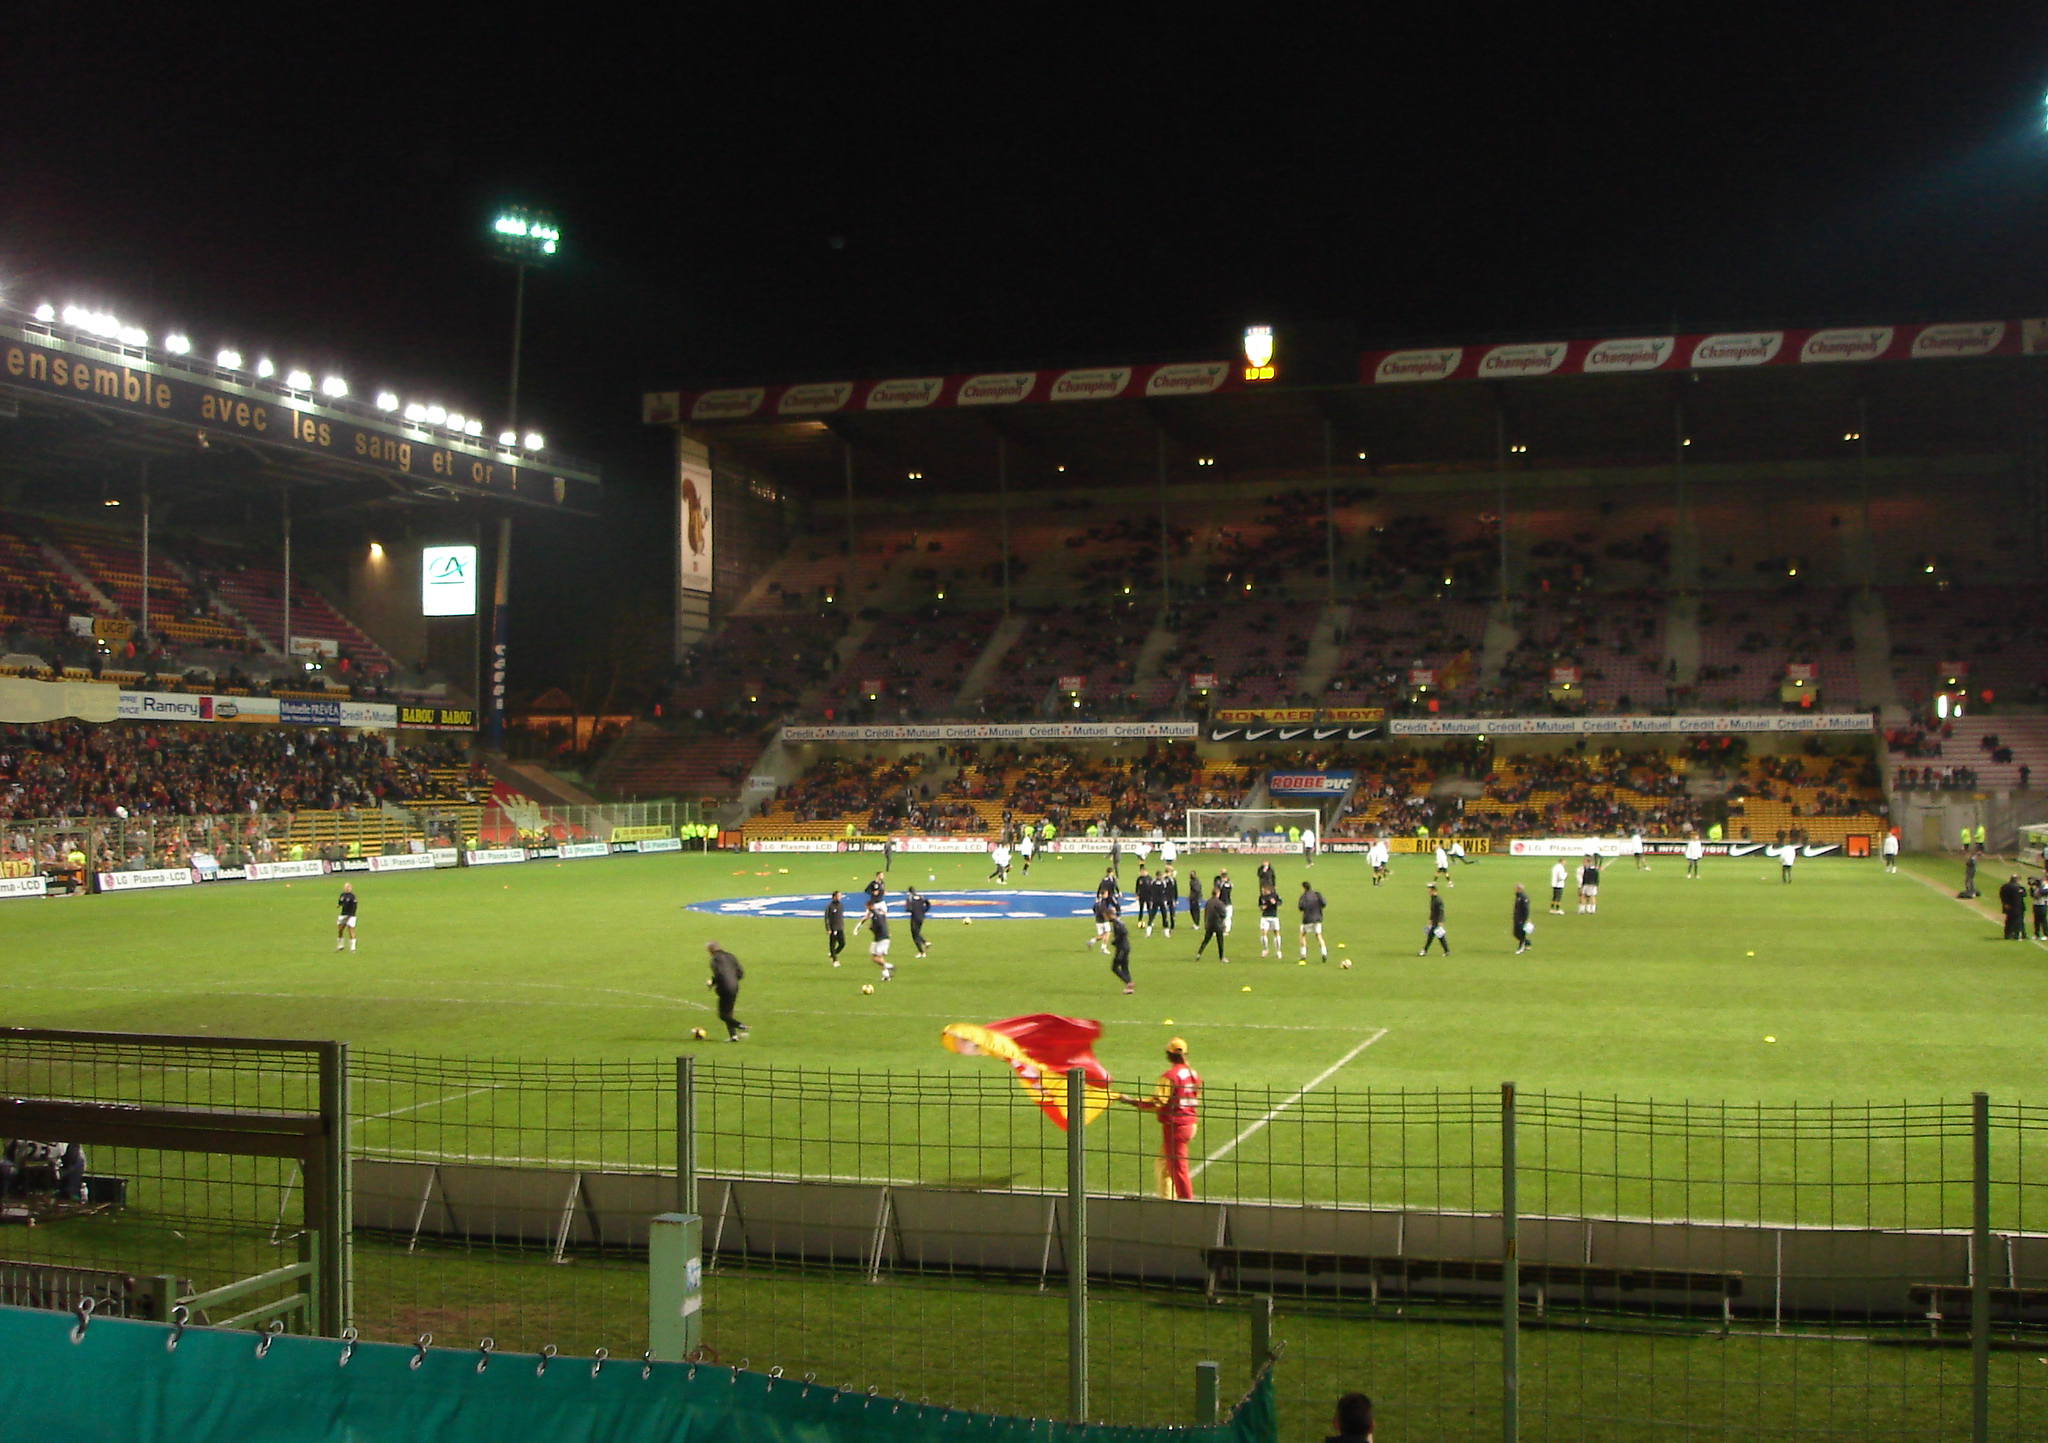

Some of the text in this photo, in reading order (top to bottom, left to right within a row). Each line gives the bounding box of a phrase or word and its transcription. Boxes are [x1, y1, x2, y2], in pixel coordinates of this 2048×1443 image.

[1485, 354, 1554, 372] Champion
[1591, 348, 1658, 366] Champion
[1382, 360, 1448, 377] Champion
[1057, 379, 1118, 395] Champion
[1152, 374, 1216, 391] Champion
[6, 347, 172, 409] ensemble
[202, 394, 267, 431] avec
[292, 409, 331, 446] les
[355, 432, 411, 472] sang
[432, 450, 453, 476] et
[472, 461, 494, 484] or
[143, 697, 199, 716] Ramery
[402, 708, 472, 726] BABOU BABOU
[1442, 722, 1480, 732] Mutuel
[1536, 721, 1575, 731] Mutuel
[1632, 719, 1671, 730] Mutuel
[1730, 718, 1770, 729] Mutuel
[1829, 717, 1870, 728] Mutuel
[827, 729, 859, 738] Mutuel
[907, 728, 940, 738] Mutuel
[988, 727, 1023, 737] Mutuel
[1073, 726, 1108, 735] Mutuel
[1159, 725, 1194, 734] Mutuel
[1271, 775, 1326, 790] ROBBE
[1333, 844, 1370, 852] Mobiles
[259, 863, 319, 875] LG Plasma LCD
[21, 881, 40, 891] LCD
[117, 876, 127, 885] LG
[133, 873, 164, 884] Plasma
[170, 872, 187, 881] LCD
